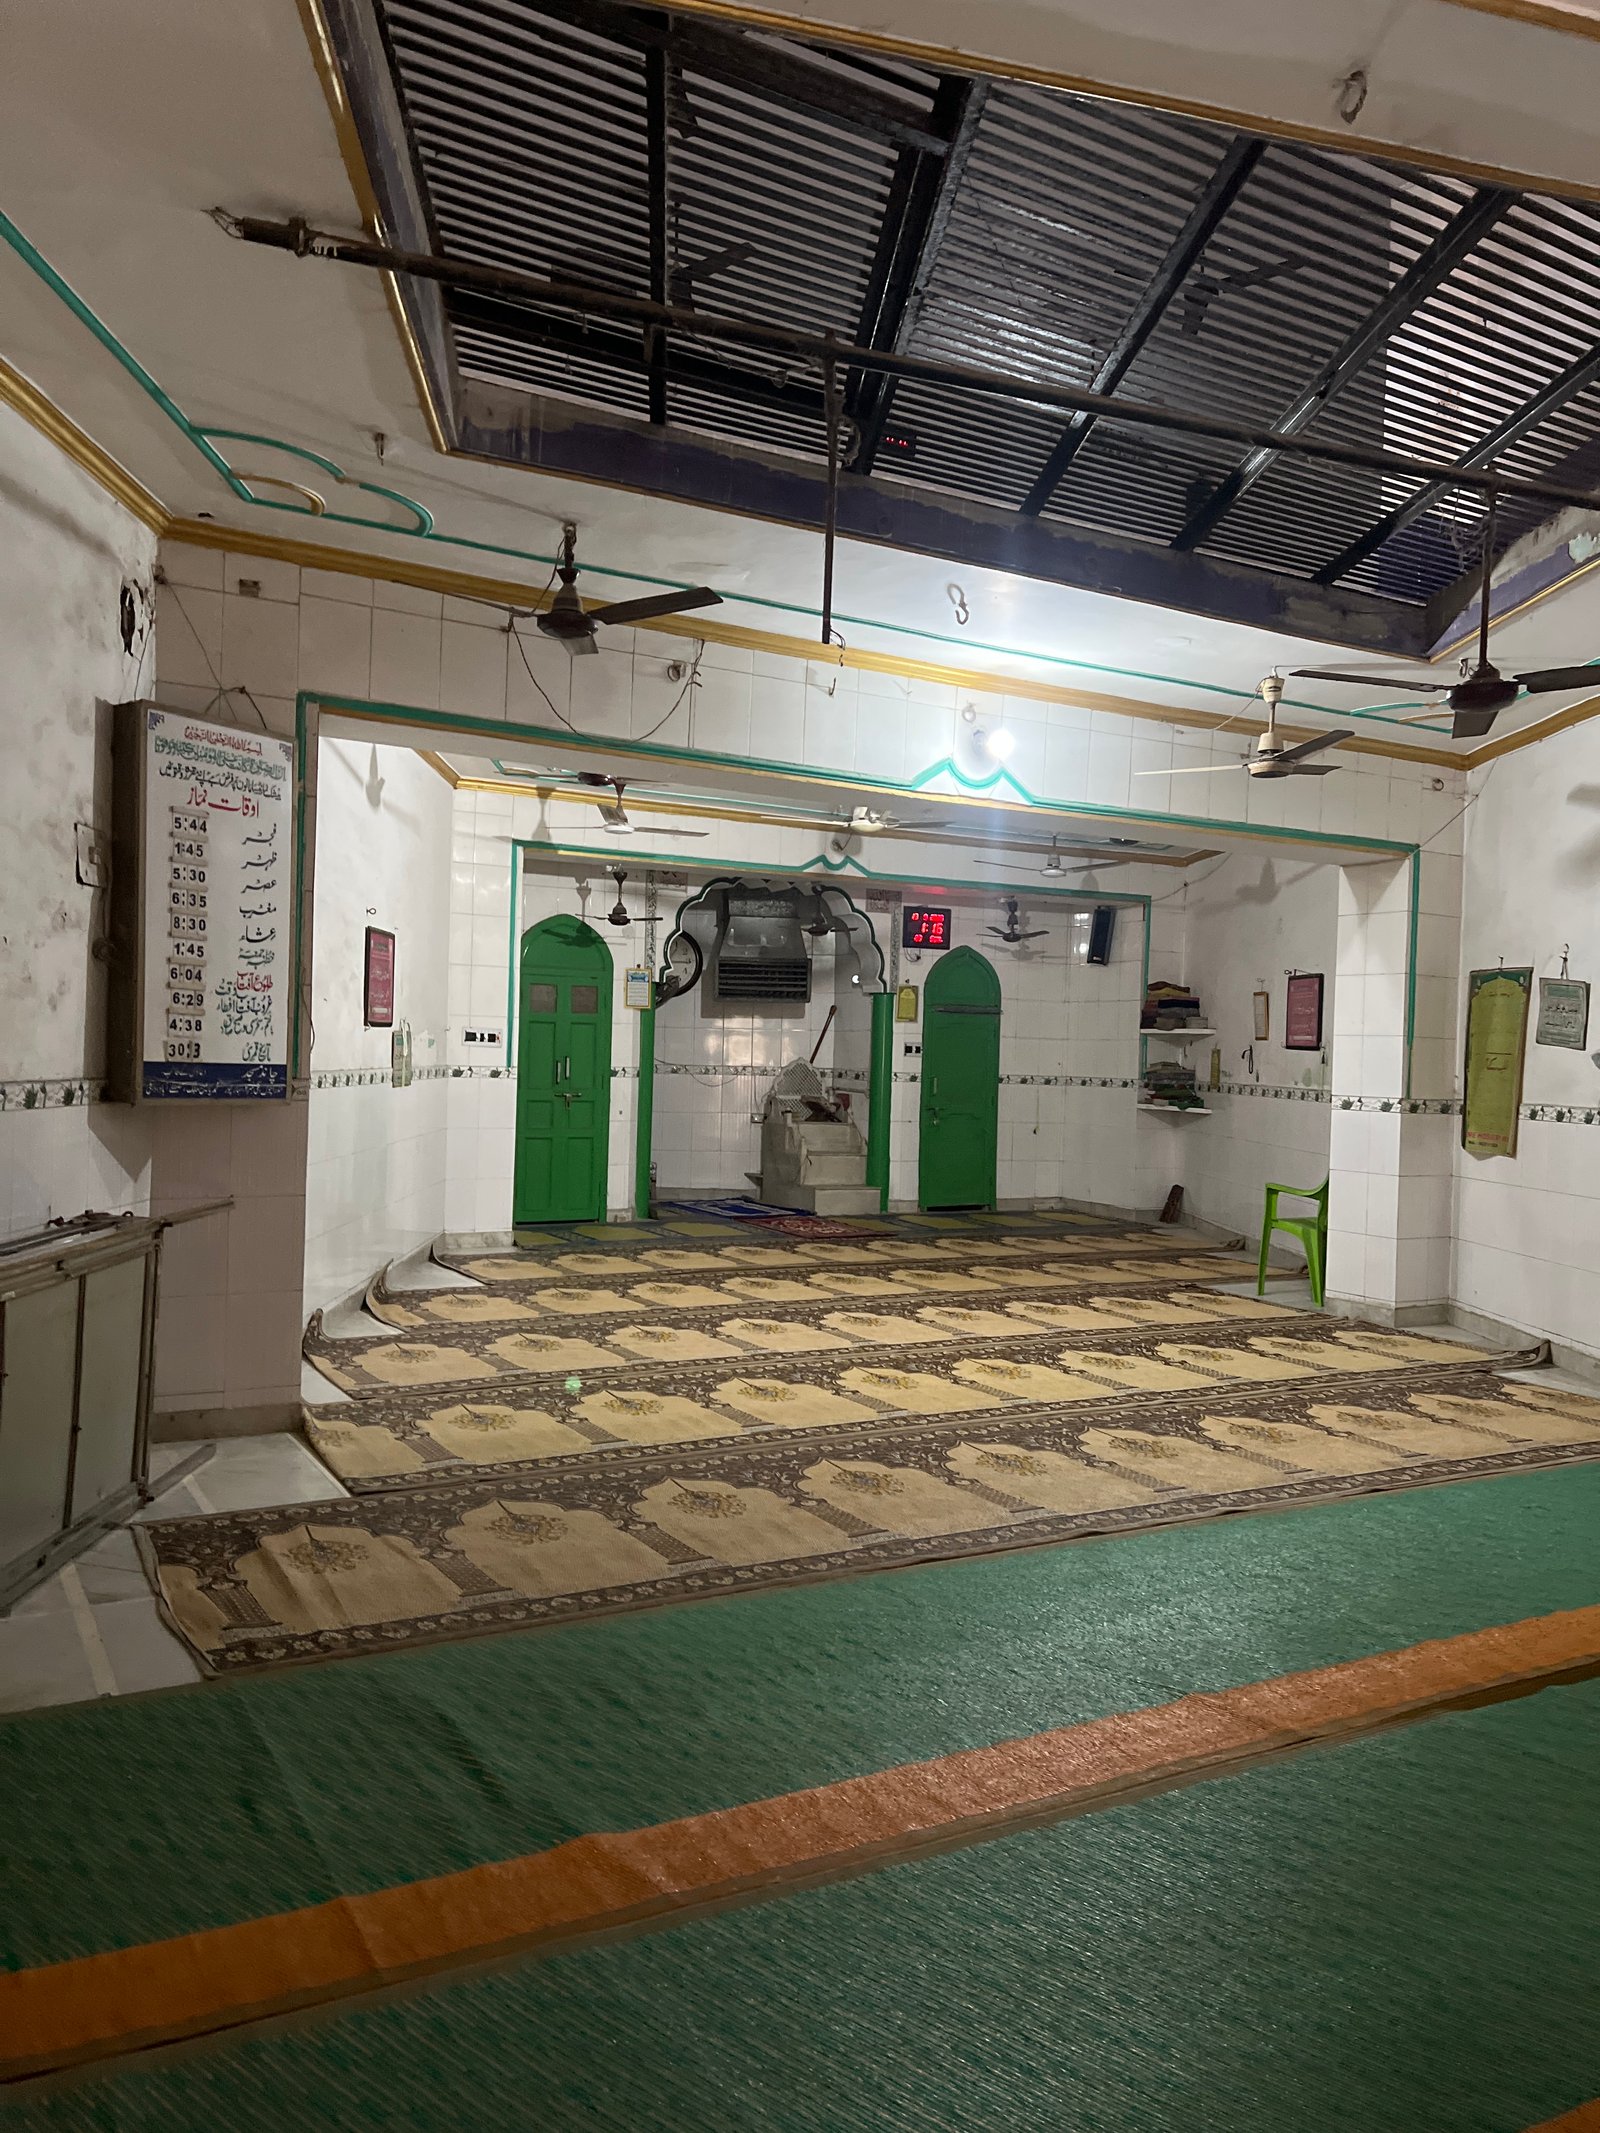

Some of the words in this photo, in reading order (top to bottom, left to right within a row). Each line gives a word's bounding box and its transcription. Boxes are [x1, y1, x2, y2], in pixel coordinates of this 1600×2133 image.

[187, 786, 207, 806] نماز
[208, 795, 259, 818] اوقات
[174, 817, 207, 833] 5:44
[241, 823, 277, 847] فجر
[175, 842, 204, 857] 1:45
[241, 851, 277, 871] ظہر
[173, 867, 206, 883] 5:30
[241, 879, 276, 894] عصر
[172, 892, 206, 908] 6:35
[239, 902, 276, 918] مغرب
[173, 916, 206, 931] 8:30
[174, 943, 204, 958] 1:45
[173, 992, 204, 1006] 6:29
[170, 1018, 202, 1032] 4:38
